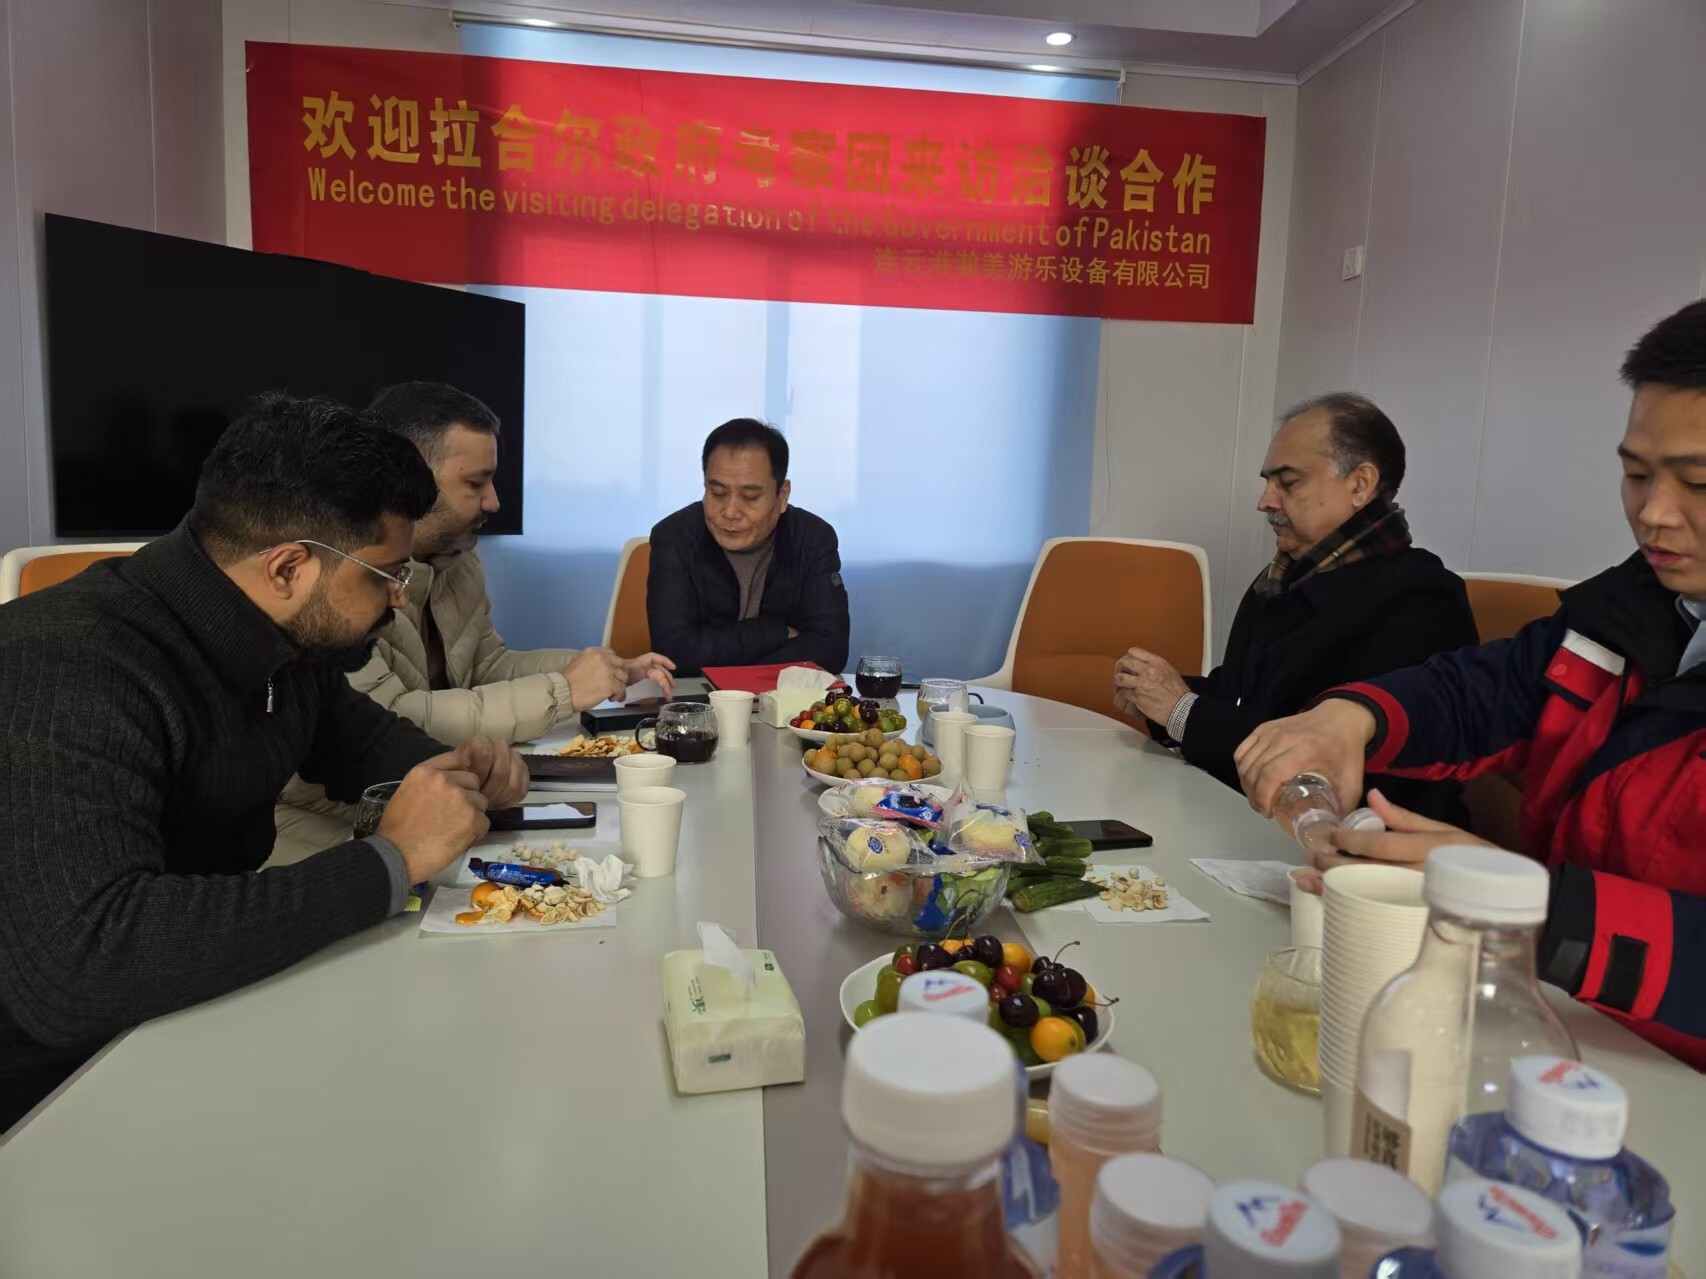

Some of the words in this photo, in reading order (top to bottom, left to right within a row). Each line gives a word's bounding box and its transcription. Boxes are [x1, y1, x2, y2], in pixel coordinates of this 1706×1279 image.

[302, 90, 1217, 214] 欢迎拉合尔政府考察团来访洽谈合作
[307, 167, 435, 208] Welcome
[441, 176, 496, 211] the
[502, 182, 615, 225] visiting
[622, 192, 781, 230] delegation
[787, 202, 821, 232] of
[828, 203, 876, 236] the
[882, 205, 1049, 246] Government
[1055, 216, 1090, 248] of
[1093, 217, 1211, 255] Pakistan
